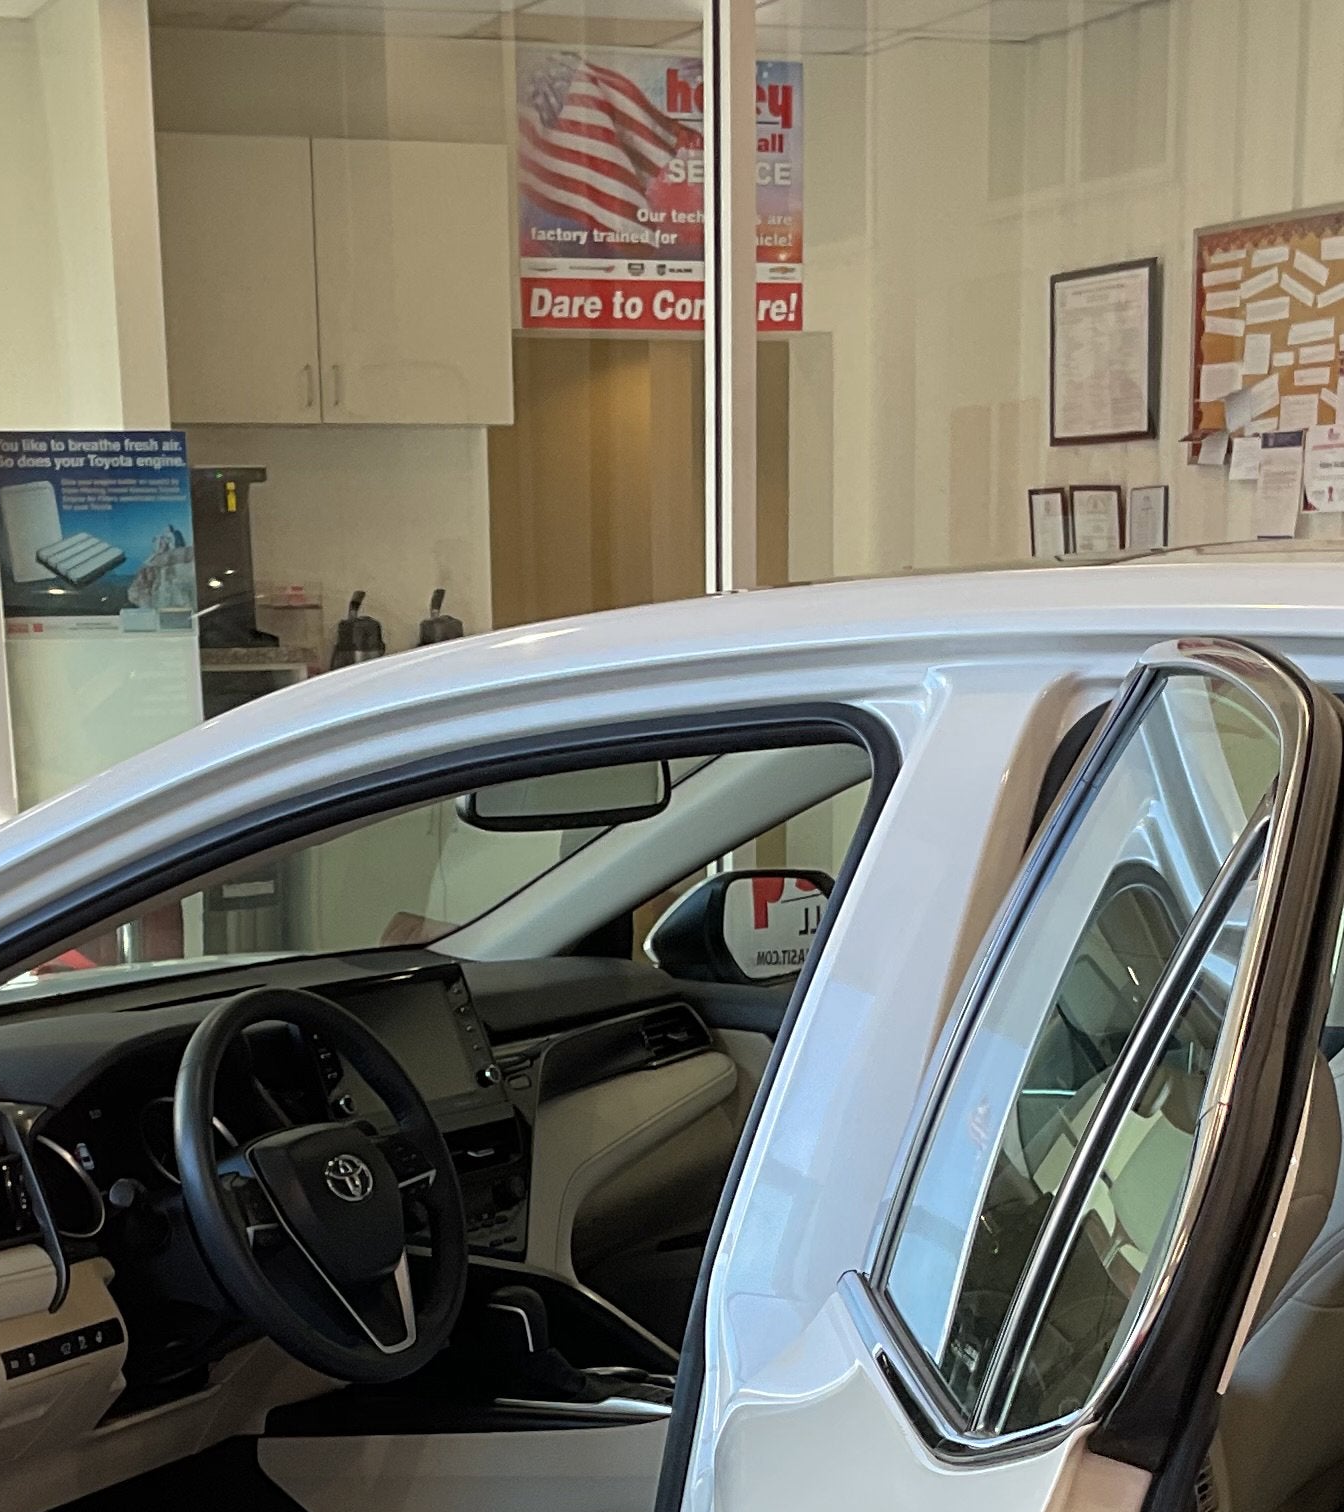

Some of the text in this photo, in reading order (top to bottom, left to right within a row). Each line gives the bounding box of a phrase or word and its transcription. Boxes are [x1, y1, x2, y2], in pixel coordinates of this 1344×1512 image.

[666, 158, 792, 186] SECE
[637, 208, 666, 224] Our
[531, 228, 588, 245] factory
[593, 229, 649, 245] trained
[530, 287, 603, 319] Dare
[611, 290, 643, 320] to
[21, 438, 47, 452] like
[50, 438, 65, 452] to
[68, 438, 121, 452] breathe
[124, 438, 159, 452] fresh
[161, 438, 183, 452] air.
[17, 455, 52, 468] does
[54, 456, 85, 471] your
[87, 454, 133, 470] Toyota
[136, 453, 187, 470] engine.
